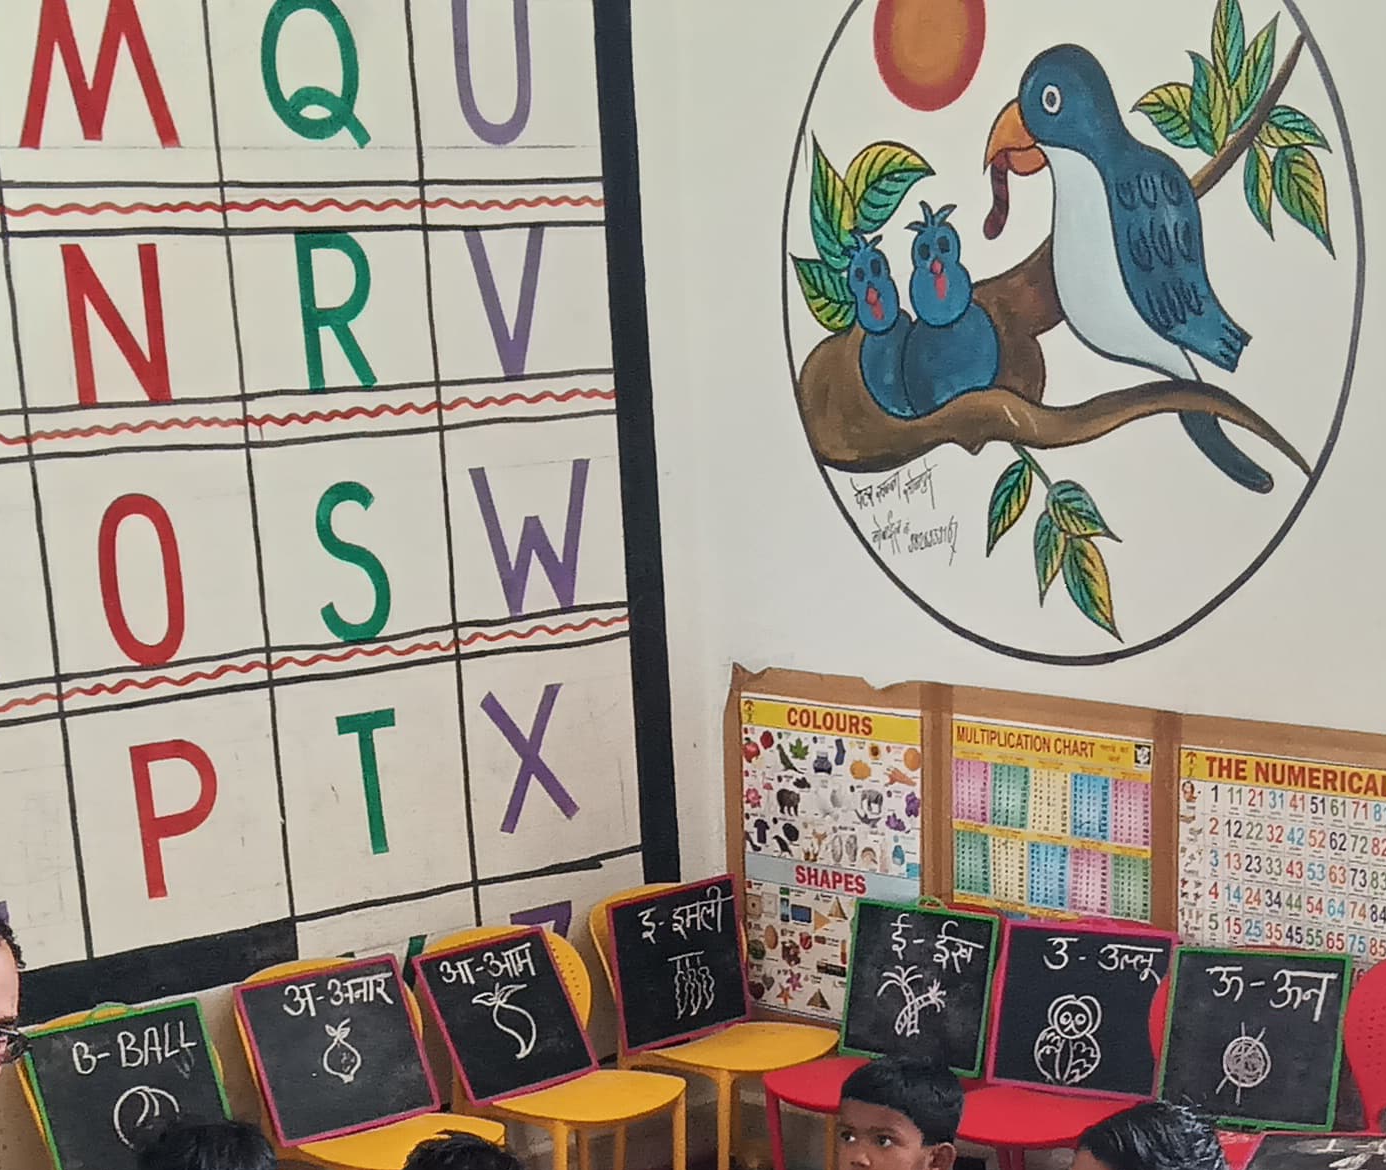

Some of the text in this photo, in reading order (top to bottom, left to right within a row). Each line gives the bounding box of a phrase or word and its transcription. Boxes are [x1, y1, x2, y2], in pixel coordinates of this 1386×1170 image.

[19, 0, 182, 149] M
[260, 0, 371, 148] Q
[452, 0, 531, 145] U
[60, 242, 173, 407] N
[294, 229, 377, 392] R
[464, 226, 544, 380] V
[98, 493, 185, 666] O
[315, 481, 390, 643] S
[469, 458, 590, 617] W
[787, 708, 873, 736] COLOURS
[956, 726, 1051, 753] MULTIPLICATION
[1053, 738, 1095, 758] CHART
[1205, 756, 1247, 780] THE
[130, 739, 217, 900] P
[336, 708, 395, 855] T
[479, 682, 580, 834] X
[1211, 785, 1218, 802] 1
[1228, 786, 1242, 805] 11
[1248, 789, 1263, 807] 21
[1269, 791, 1284, 809] 31
[1289, 793, 1305, 812] 41
[1310, 797, 1325, 815] 51
[1330, 799, 1346, 818] 61
[1352, 801, 1368, 819] 71
[1209, 817, 1219, 835] 2
[1225, 819, 1242, 838] 12
[1246, 821, 1263, 840] 22
[1266, 824, 1283, 843] 32
[1287, 827, 1304, 846] 42
[1308, 830, 1326, 848] 52
[1330, 832, 1347, 851] 62
[1351, 835, 1368, 854] 72
[795, 865, 866, 894] SHAPES
[1210, 850, 1219, 867] 3
[1225, 852, 1242, 870] 13
[1245, 855, 1262, 873] 23
[1266, 857, 1282, 876] 33
[1286, 860, 1303, 879] 43
[1307, 863, 1325, 881] 53
[1329, 866, 1346, 884] 63
[1350, 868, 1367, 887] 73
[1209, 881, 1219, 899] 4
[1225, 883, 1242, 903] 14
[1245, 887, 1261, 906] 24
[1265, 889, 1282, 908] 34
[1285, 893, 1302, 911] 44
[1307, 896, 1323, 914] 54
[1328, 898, 1345, 918] 64
[1350, 901, 1366, 920] 74
[1370, 904, 1386, 924] 84
[1209, 913, 1218, 930] 5
[1225, 916, 1242, 934] 15
[1245, 919, 1262, 937] 25
[1265, 922, 1282, 940] 35
[1285, 925, 1303, 944] 45
[1306, 928, 1323, 947] 55
[1326, 932, 1344, 950] 65
[1349, 934, 1366, 953] 75
[1370, 937, 1386, 957] 85
